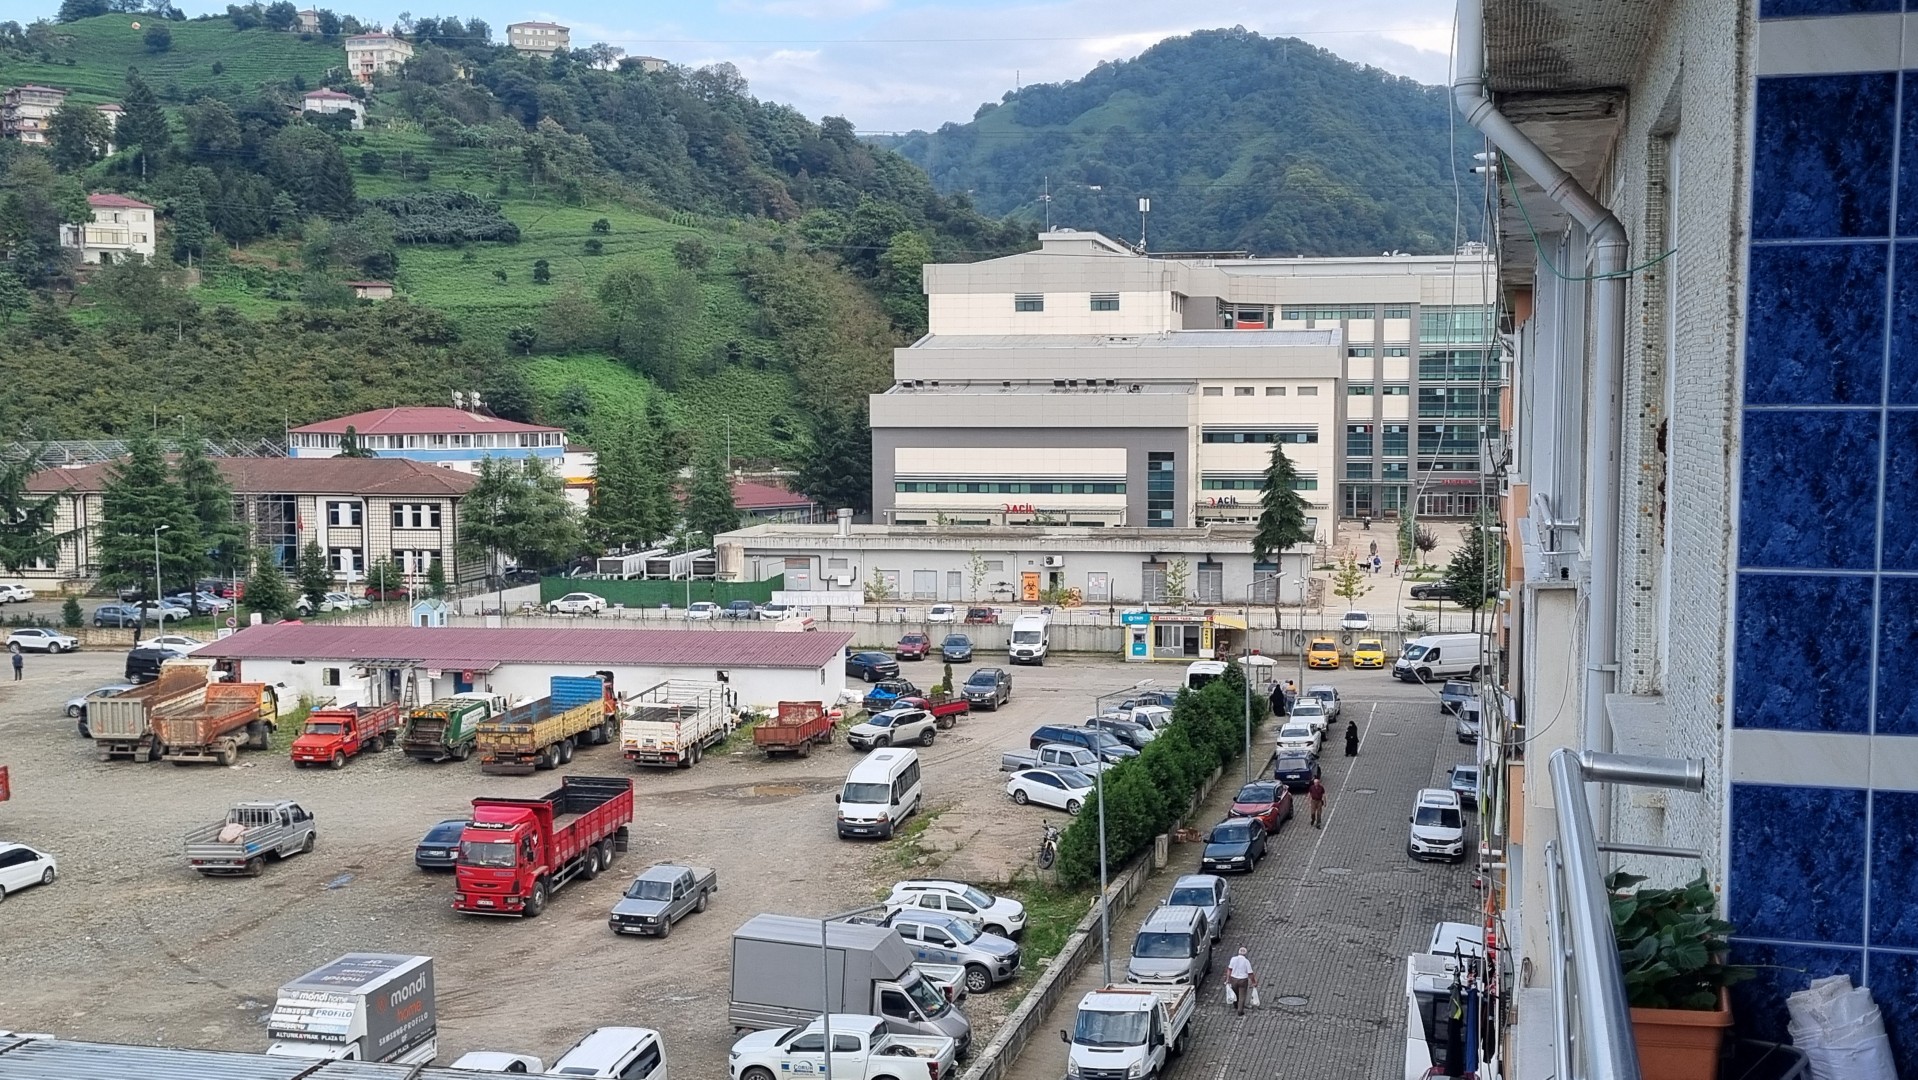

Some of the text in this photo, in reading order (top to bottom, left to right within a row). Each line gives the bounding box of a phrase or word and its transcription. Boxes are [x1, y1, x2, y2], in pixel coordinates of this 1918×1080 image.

[1217, 495, 1239, 505] ACİL
[1012, 502, 1034, 513] ACİL
[390, 971, 427, 1008] mondi
[299, 992, 329, 1003] mondi
[277, 1006, 312, 1016] SAMSUNG
[396, 999, 423, 1022] home
